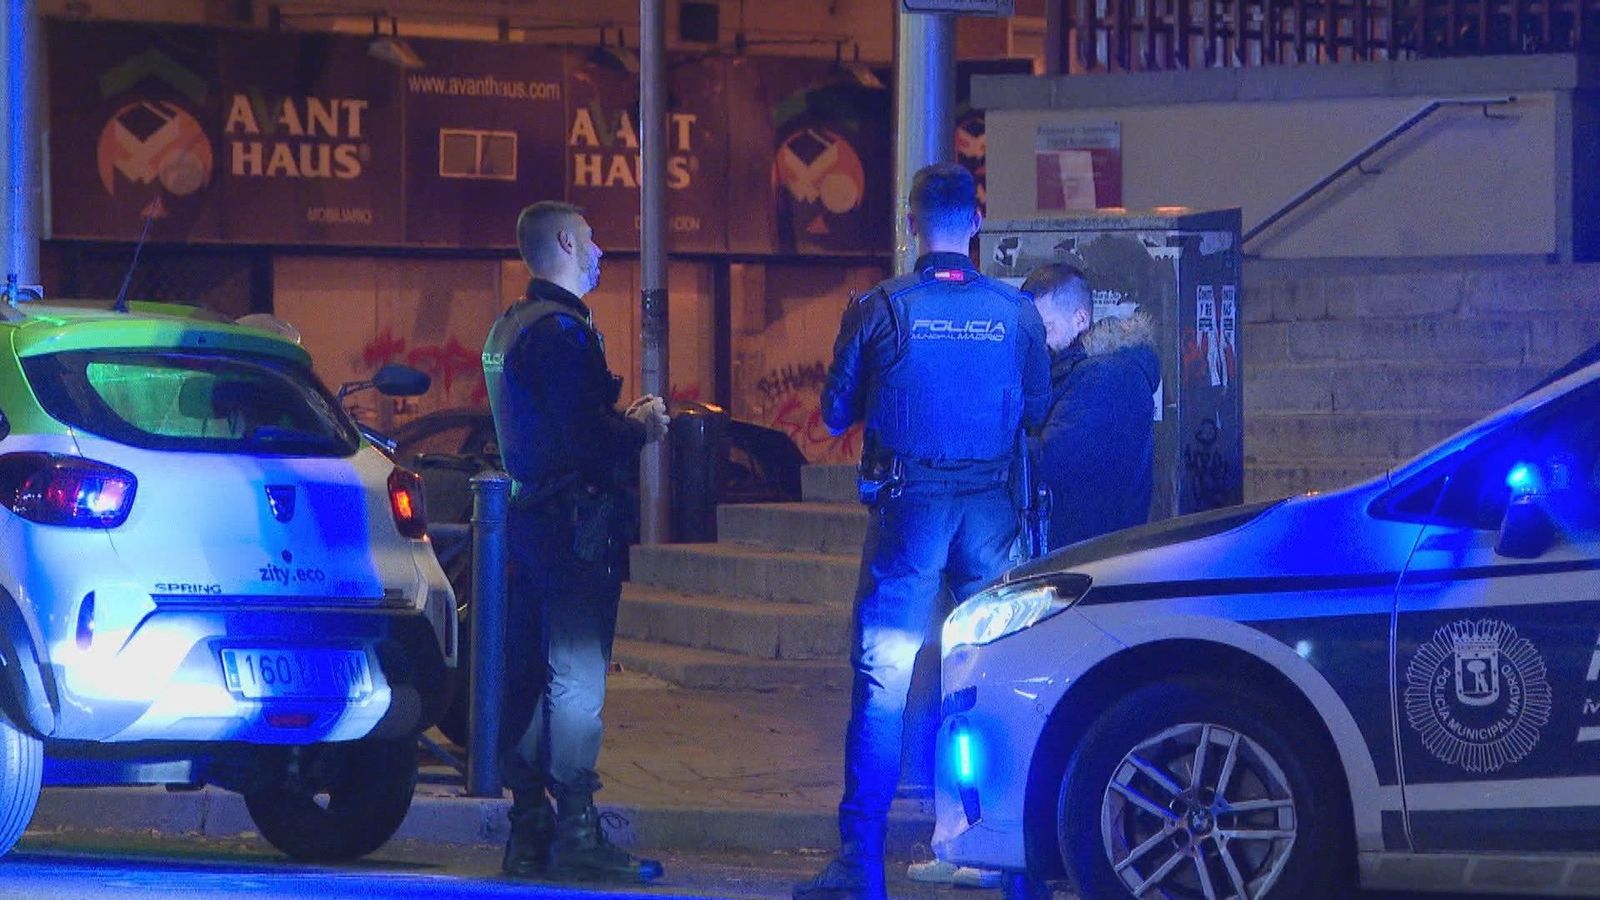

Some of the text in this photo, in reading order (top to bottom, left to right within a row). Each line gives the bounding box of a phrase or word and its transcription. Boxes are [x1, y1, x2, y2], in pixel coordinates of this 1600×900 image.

[408, 74, 561, 101] www.avanthaus.com
[225, 93, 369, 138] AVANT
[569, 107, 697, 151] AVAT
[574, 153, 692, 190] HAS
[154, 583, 222, 594] SPRING
[259, 563, 326, 586] zity.eco
[1449, 717, 1513, 741] MUNICIPAL
[1500, 663, 1522, 717] MADRID
